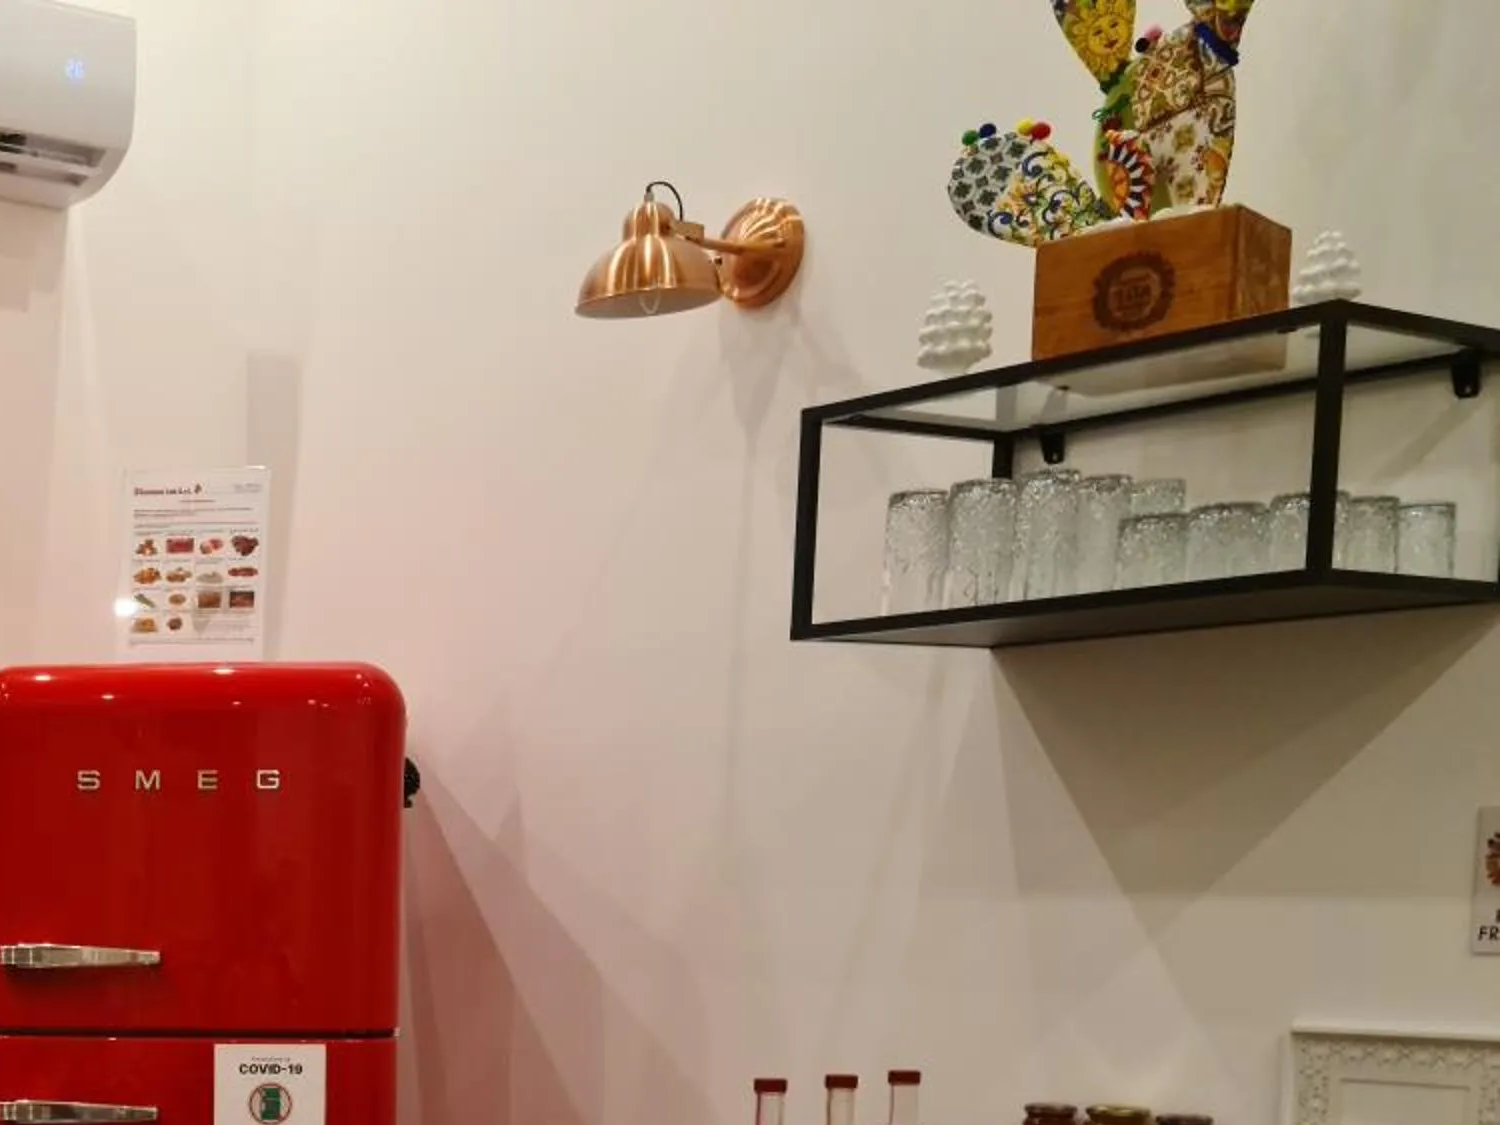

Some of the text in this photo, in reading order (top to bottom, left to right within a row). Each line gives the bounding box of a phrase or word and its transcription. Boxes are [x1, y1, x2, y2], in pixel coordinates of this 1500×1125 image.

[76, 769, 281, 791] SMEG
[1477, 925, 1500, 941] FR
[239, 1063, 303, 1075] COVID-19
